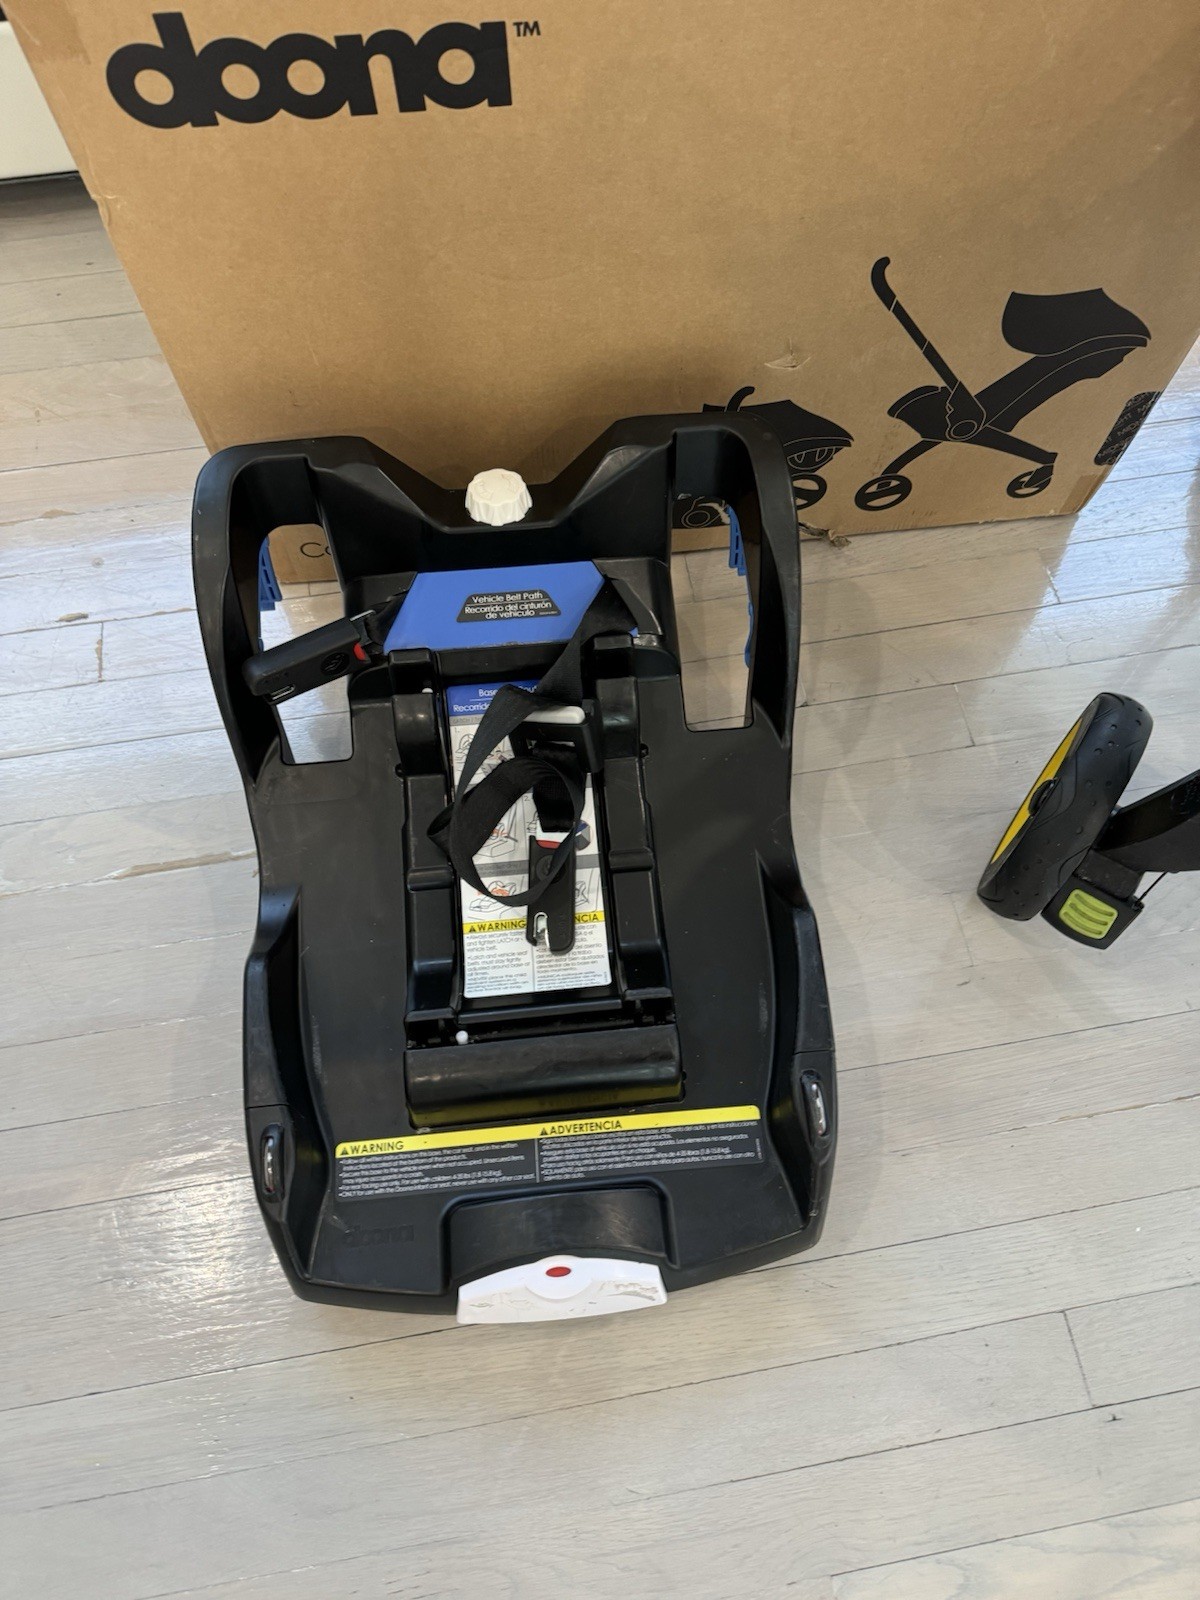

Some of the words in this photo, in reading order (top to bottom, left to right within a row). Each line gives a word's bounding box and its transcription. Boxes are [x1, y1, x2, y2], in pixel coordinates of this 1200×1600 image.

[106, 12, 512, 129] doona
[472, 594, 504, 603] Vehicle
[506, 593, 521, 601] Belt
[523, 591, 543, 600] Path
[465, 605, 504, 614] Recorrido
[505, 603, 518, 611] del
[520, 601, 552, 610] cinturón
[485, 611, 497, 619] de
[477, 920, 526, 931] WARNING
[549, 1120, 622, 1135] ADVERTENCIA
[350, 1141, 404, 1154] WARNING
